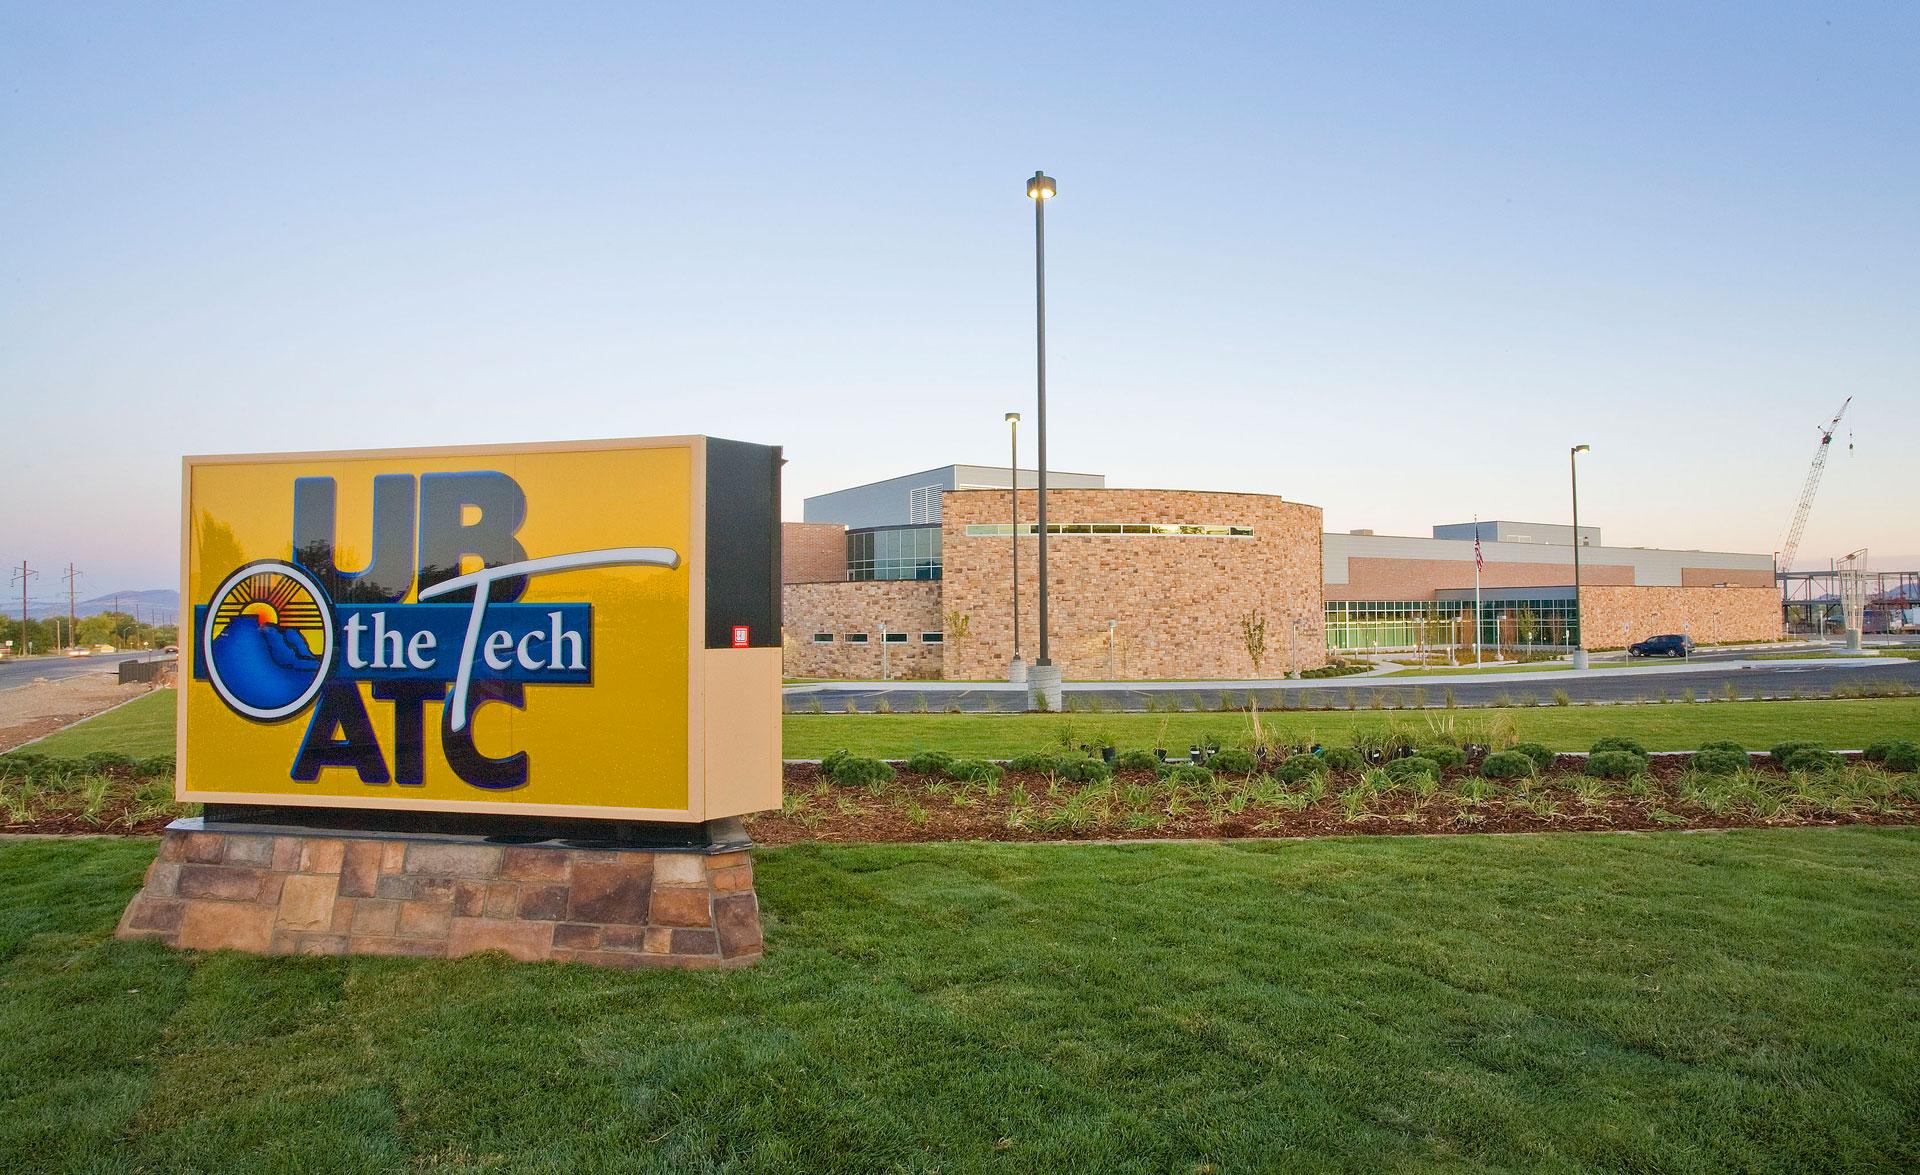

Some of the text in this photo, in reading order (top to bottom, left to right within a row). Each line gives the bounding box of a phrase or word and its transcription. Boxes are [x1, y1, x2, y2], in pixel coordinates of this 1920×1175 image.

[292, 471, 528, 605] UB
[344, 547, 680, 732] the Tech
[291, 681, 528, 790] ATC
